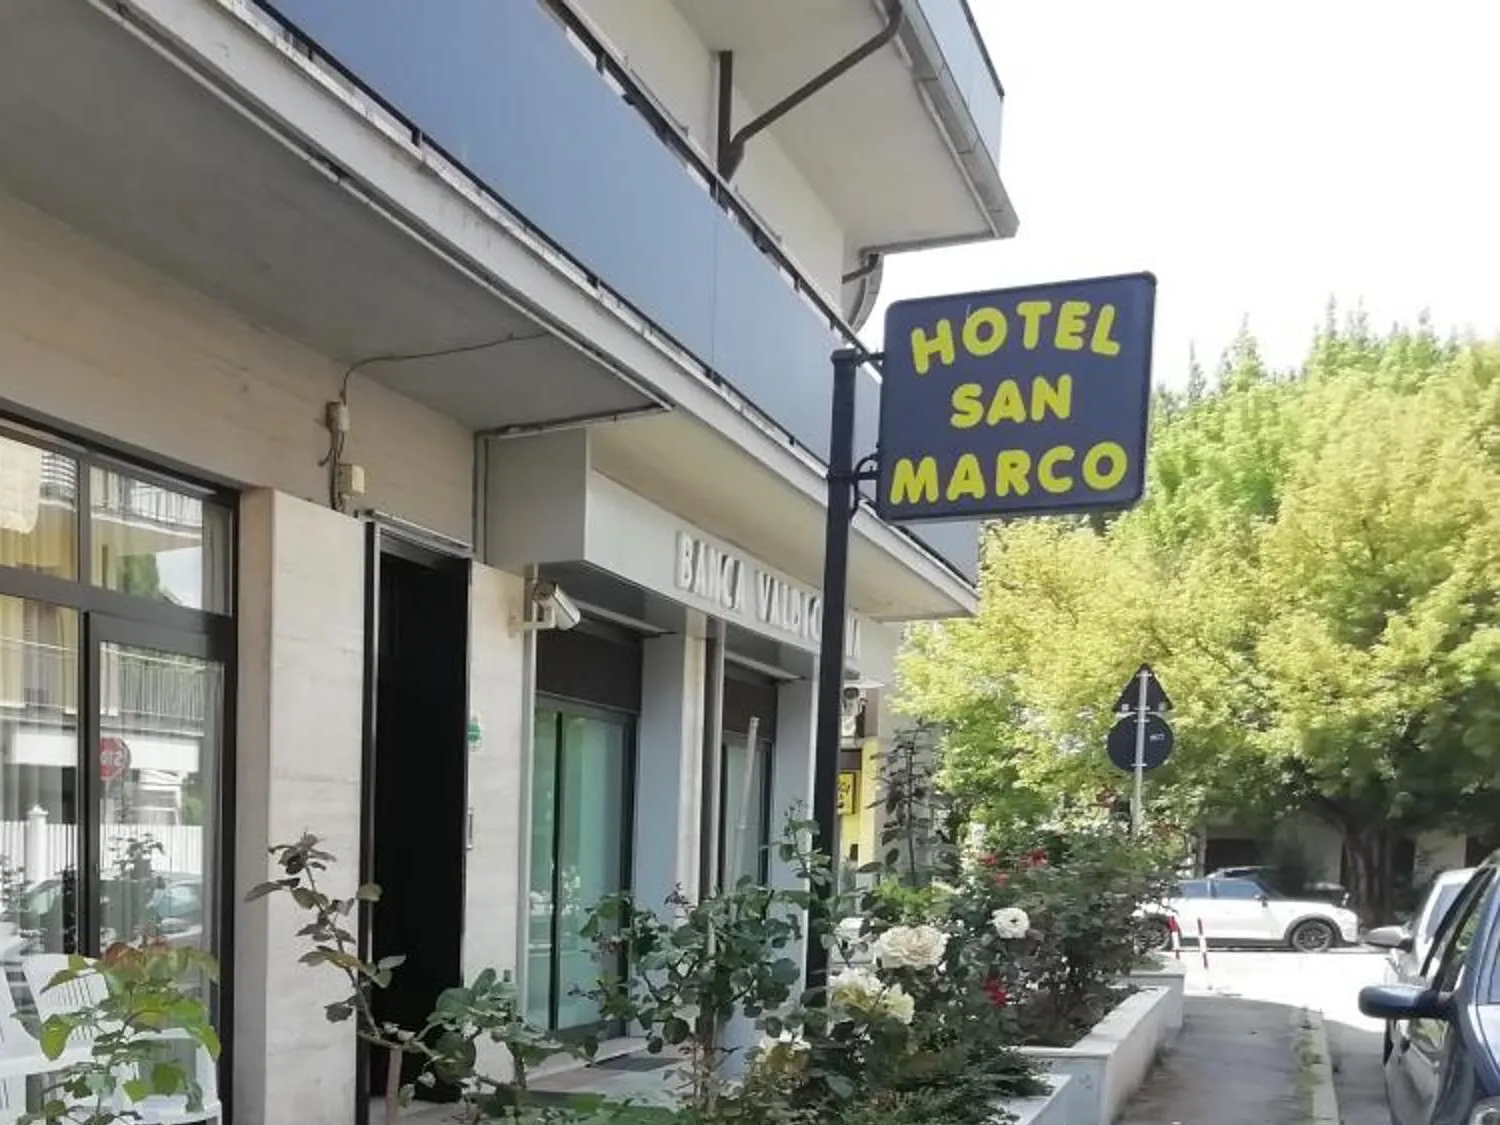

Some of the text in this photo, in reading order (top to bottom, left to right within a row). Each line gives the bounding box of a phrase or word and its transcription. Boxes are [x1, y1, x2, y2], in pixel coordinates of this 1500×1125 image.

[911, 301, 1121, 374] HOTEL
[950, 374, 1072, 429] SAN
[890, 441, 1127, 504] MARCO
[679, 531, 746, 613] BANCA
